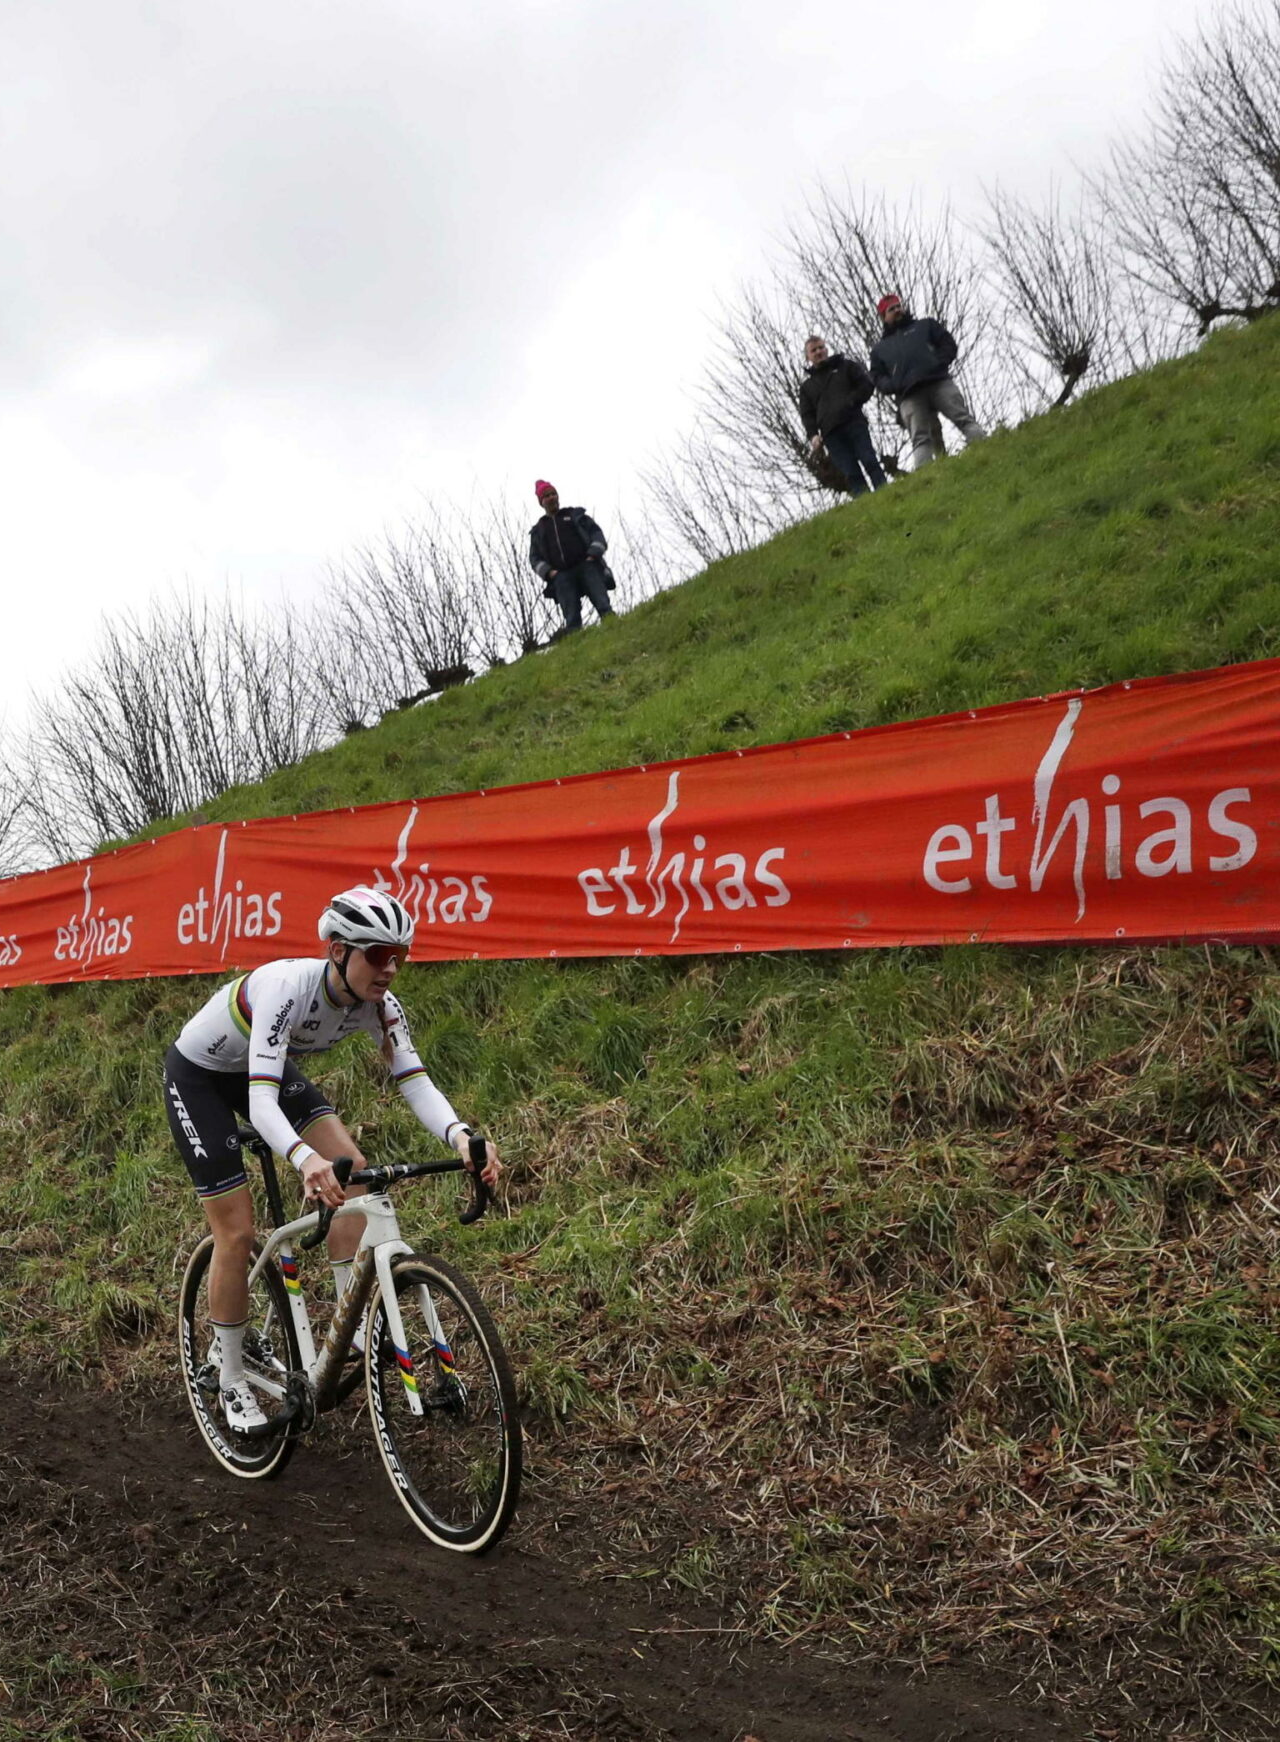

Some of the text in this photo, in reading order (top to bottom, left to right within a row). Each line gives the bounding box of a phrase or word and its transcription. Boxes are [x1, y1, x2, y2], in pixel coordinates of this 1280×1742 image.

[578, 771, 791, 944] ethias
[922, 699, 1258, 923] ethias
[54, 865, 133, 975] ethias
[177, 829, 282, 962] ethias
[270, 998, 295, 1033] Baloise
[389, 1031, 399, 1047] 1
[169, 1081, 209, 1159] TREK
[182, 1316, 233, 1459] BONTRAGER
[372, 1309, 409, 1490] BONTRAGER
